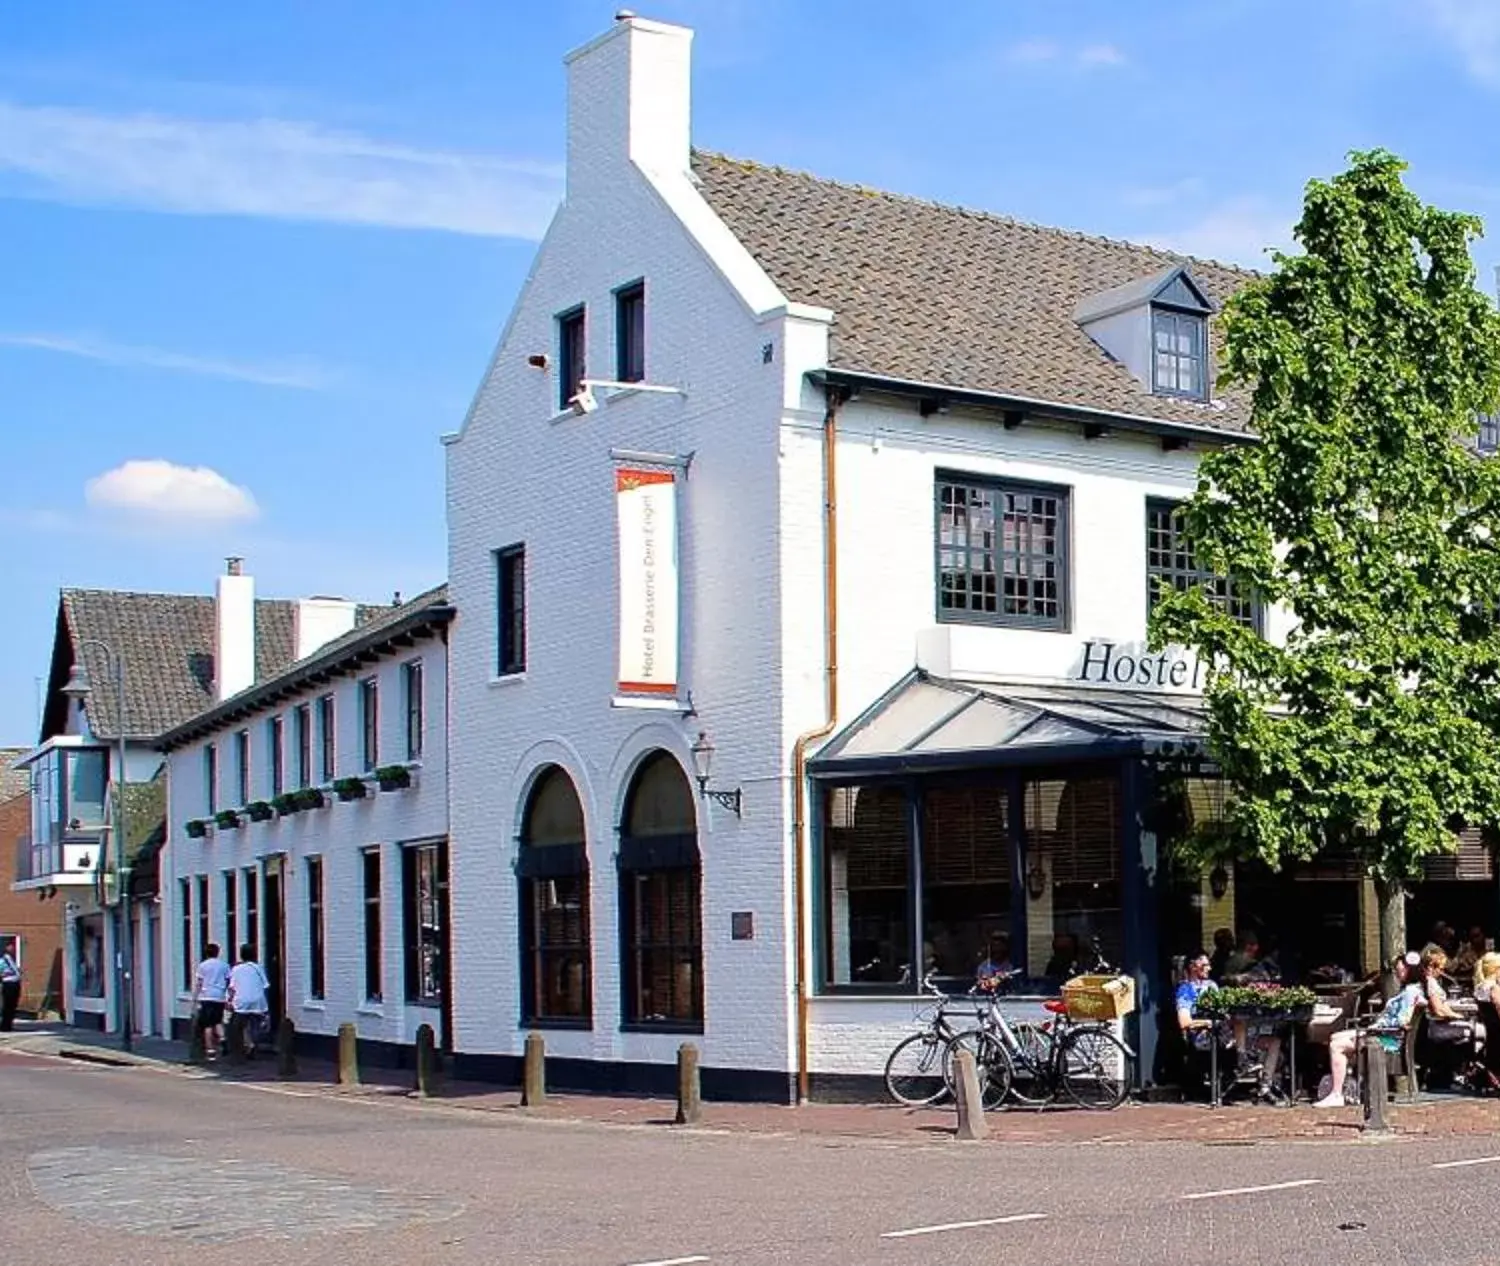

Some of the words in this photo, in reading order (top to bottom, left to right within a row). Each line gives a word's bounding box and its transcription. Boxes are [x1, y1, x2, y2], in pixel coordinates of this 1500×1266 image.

[643, 539, 655, 566] Den
[643, 570, 656, 634] Brasserie
[641, 638, 655, 677] Hotel
[1075, 640, 1225, 690] Hostel
